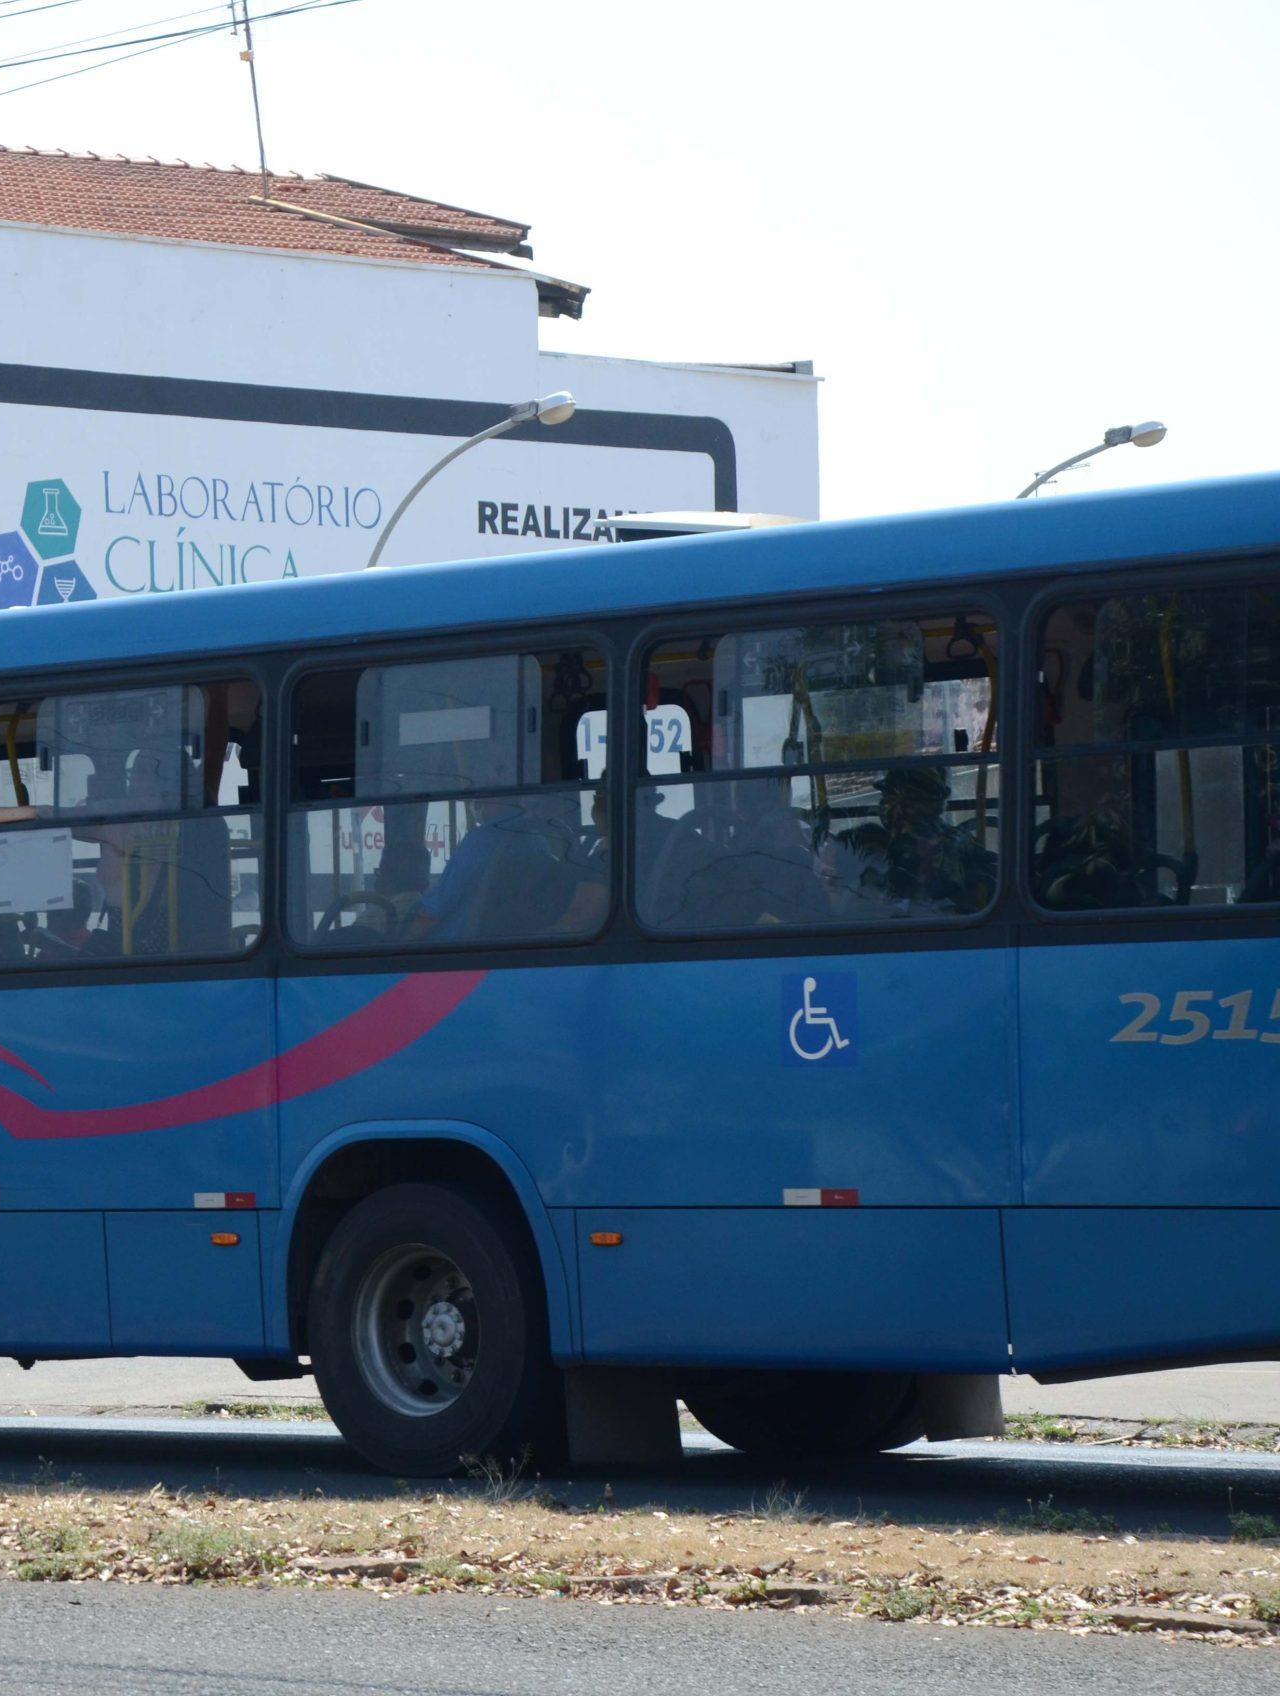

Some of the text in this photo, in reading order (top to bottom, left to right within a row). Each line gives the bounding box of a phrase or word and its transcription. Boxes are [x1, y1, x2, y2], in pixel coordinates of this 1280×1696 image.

[102, 471, 382, 530] LABORATÓRIO
[477, 499, 656, 543] REALIZA
[105, 526, 299, 593] CLÍNICA
